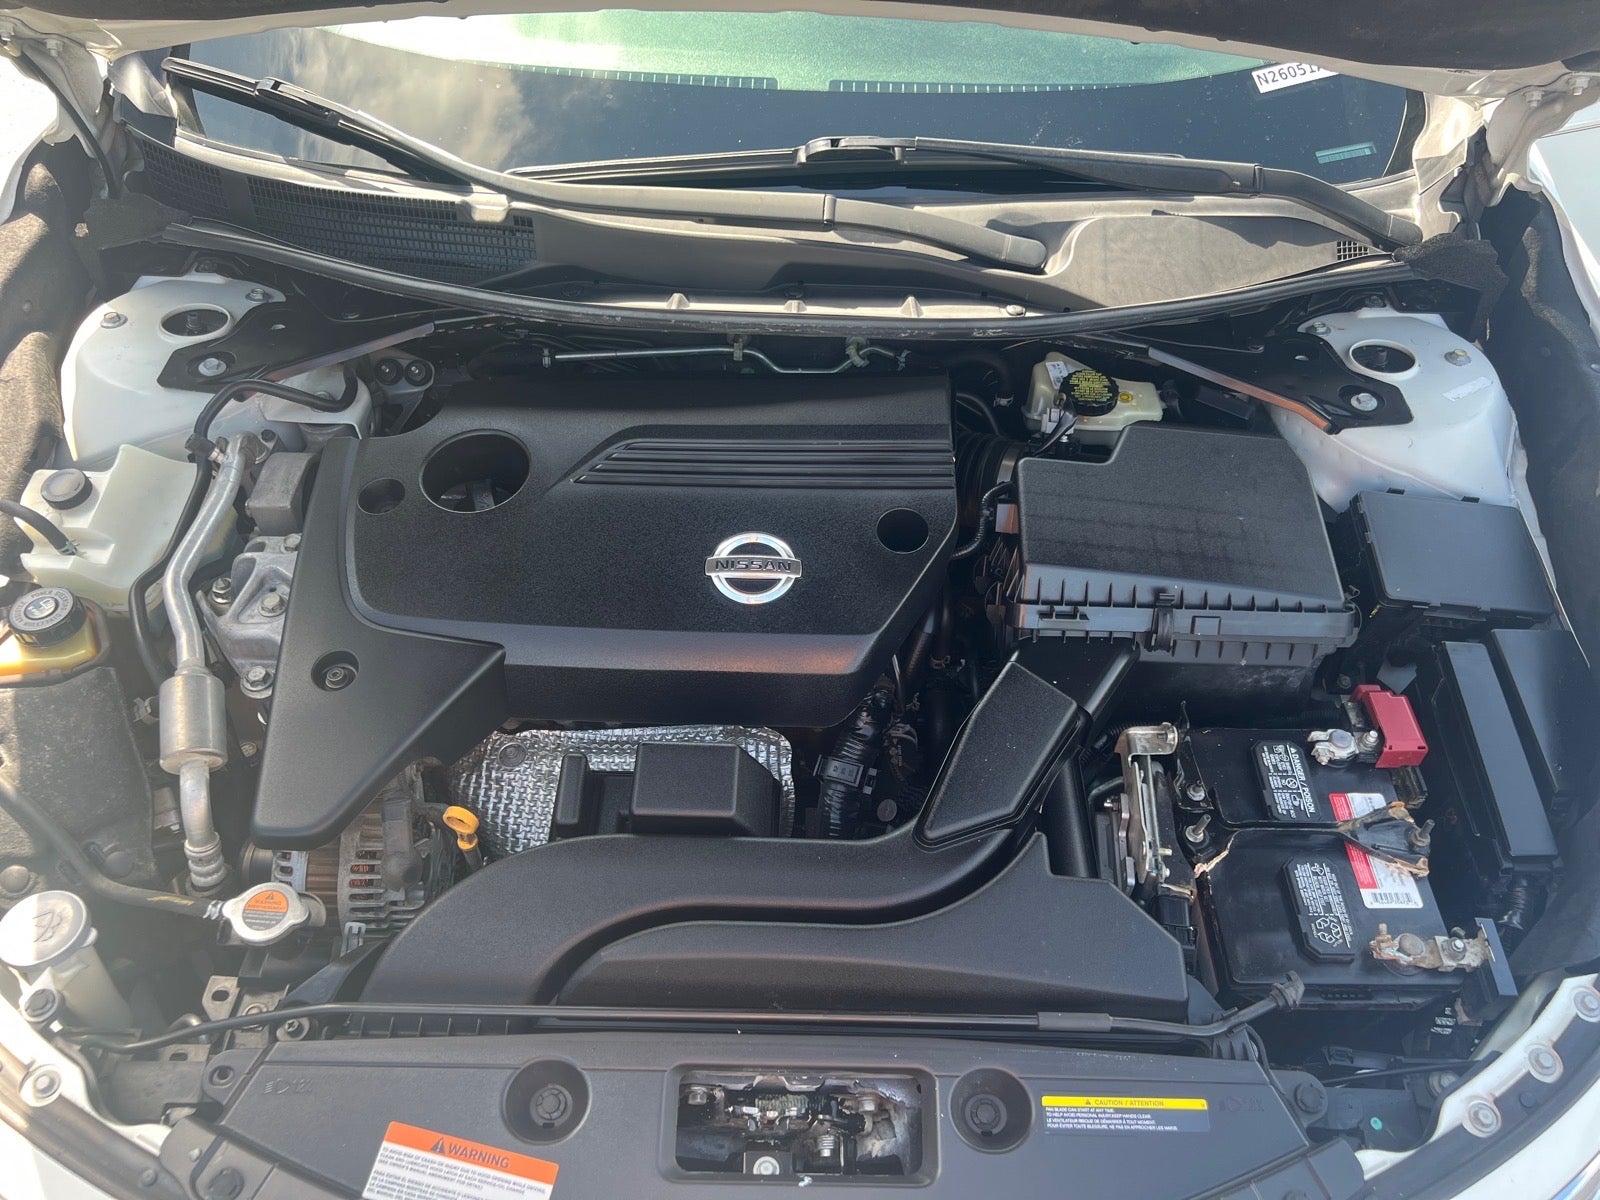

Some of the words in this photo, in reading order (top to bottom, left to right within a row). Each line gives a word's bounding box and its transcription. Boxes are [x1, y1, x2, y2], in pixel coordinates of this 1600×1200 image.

[1256, 64, 1320, 86] N26051
[715, 559, 792, 572] NISSAN
[1291, 753, 1305, 780] DANGER
[1301, 787, 1315, 813] POISON
[449, 1142, 511, 1169] WARNING
